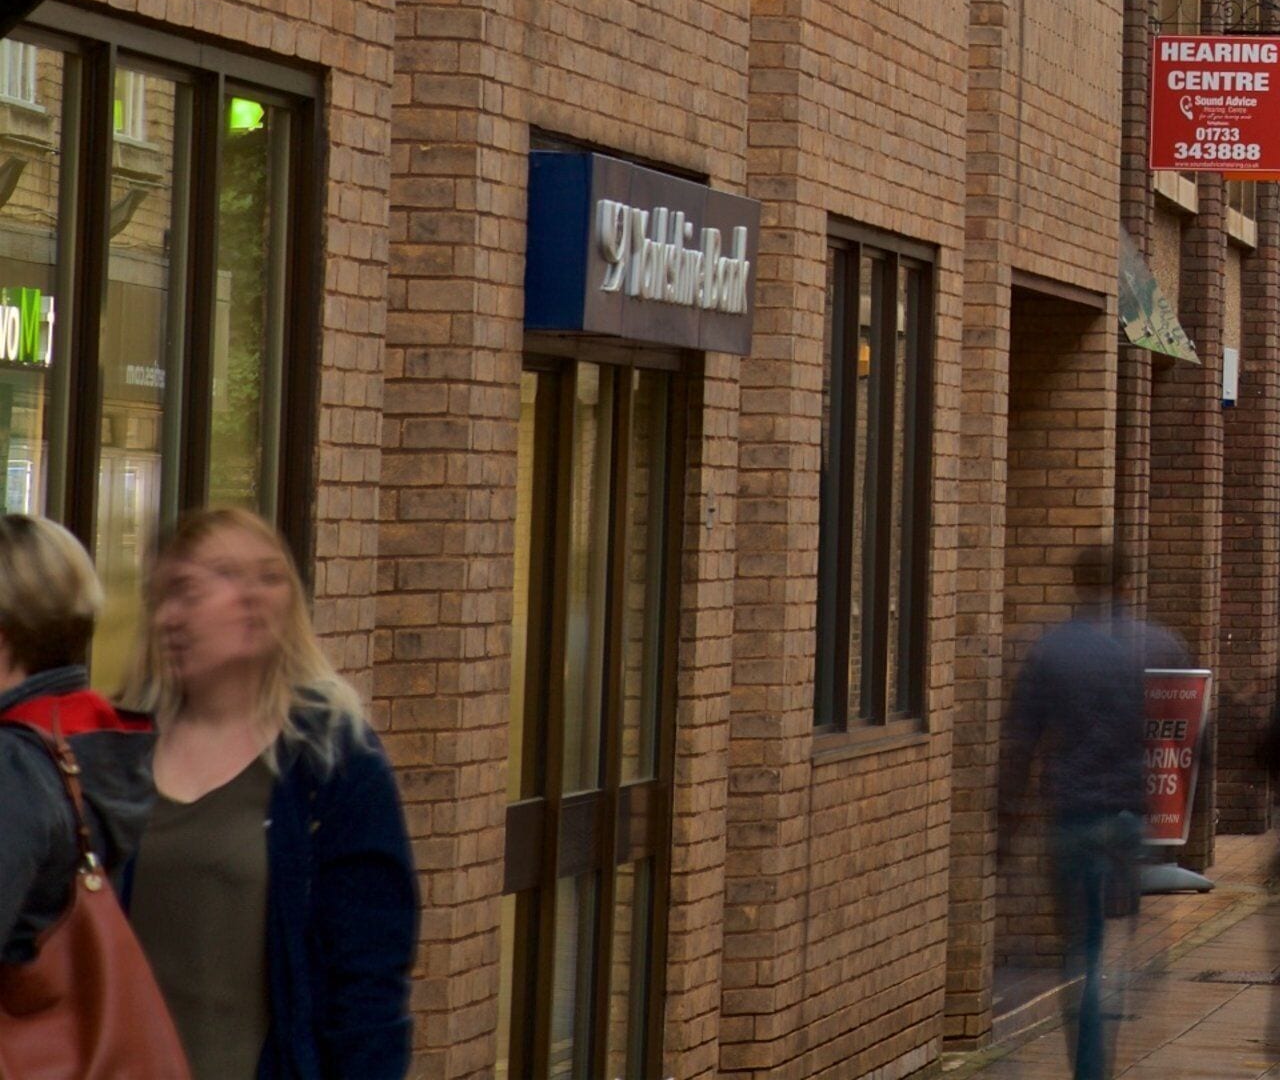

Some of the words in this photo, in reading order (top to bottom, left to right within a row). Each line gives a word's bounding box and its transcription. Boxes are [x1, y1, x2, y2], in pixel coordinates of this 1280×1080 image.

[1161, 42, 1278, 63] HEARING
[1168, 70, 1270, 91] CENTRE
[1194, 95, 1224, 107] Sound
[1225, 96, 1258, 107] Advice
[1196, 127, 1240, 141] 01733
[1174, 142, 1261, 160] 343888
[1150, 689, 1178, 699] ABOUT
[1178, 689, 1197, 699] OUR
[1145, 720, 1187, 739] REE
[1143, 748, 1192, 768] ARING
[1145, 774, 1178, 795] STS
[1151, 814, 1180, 824] WITHIN
